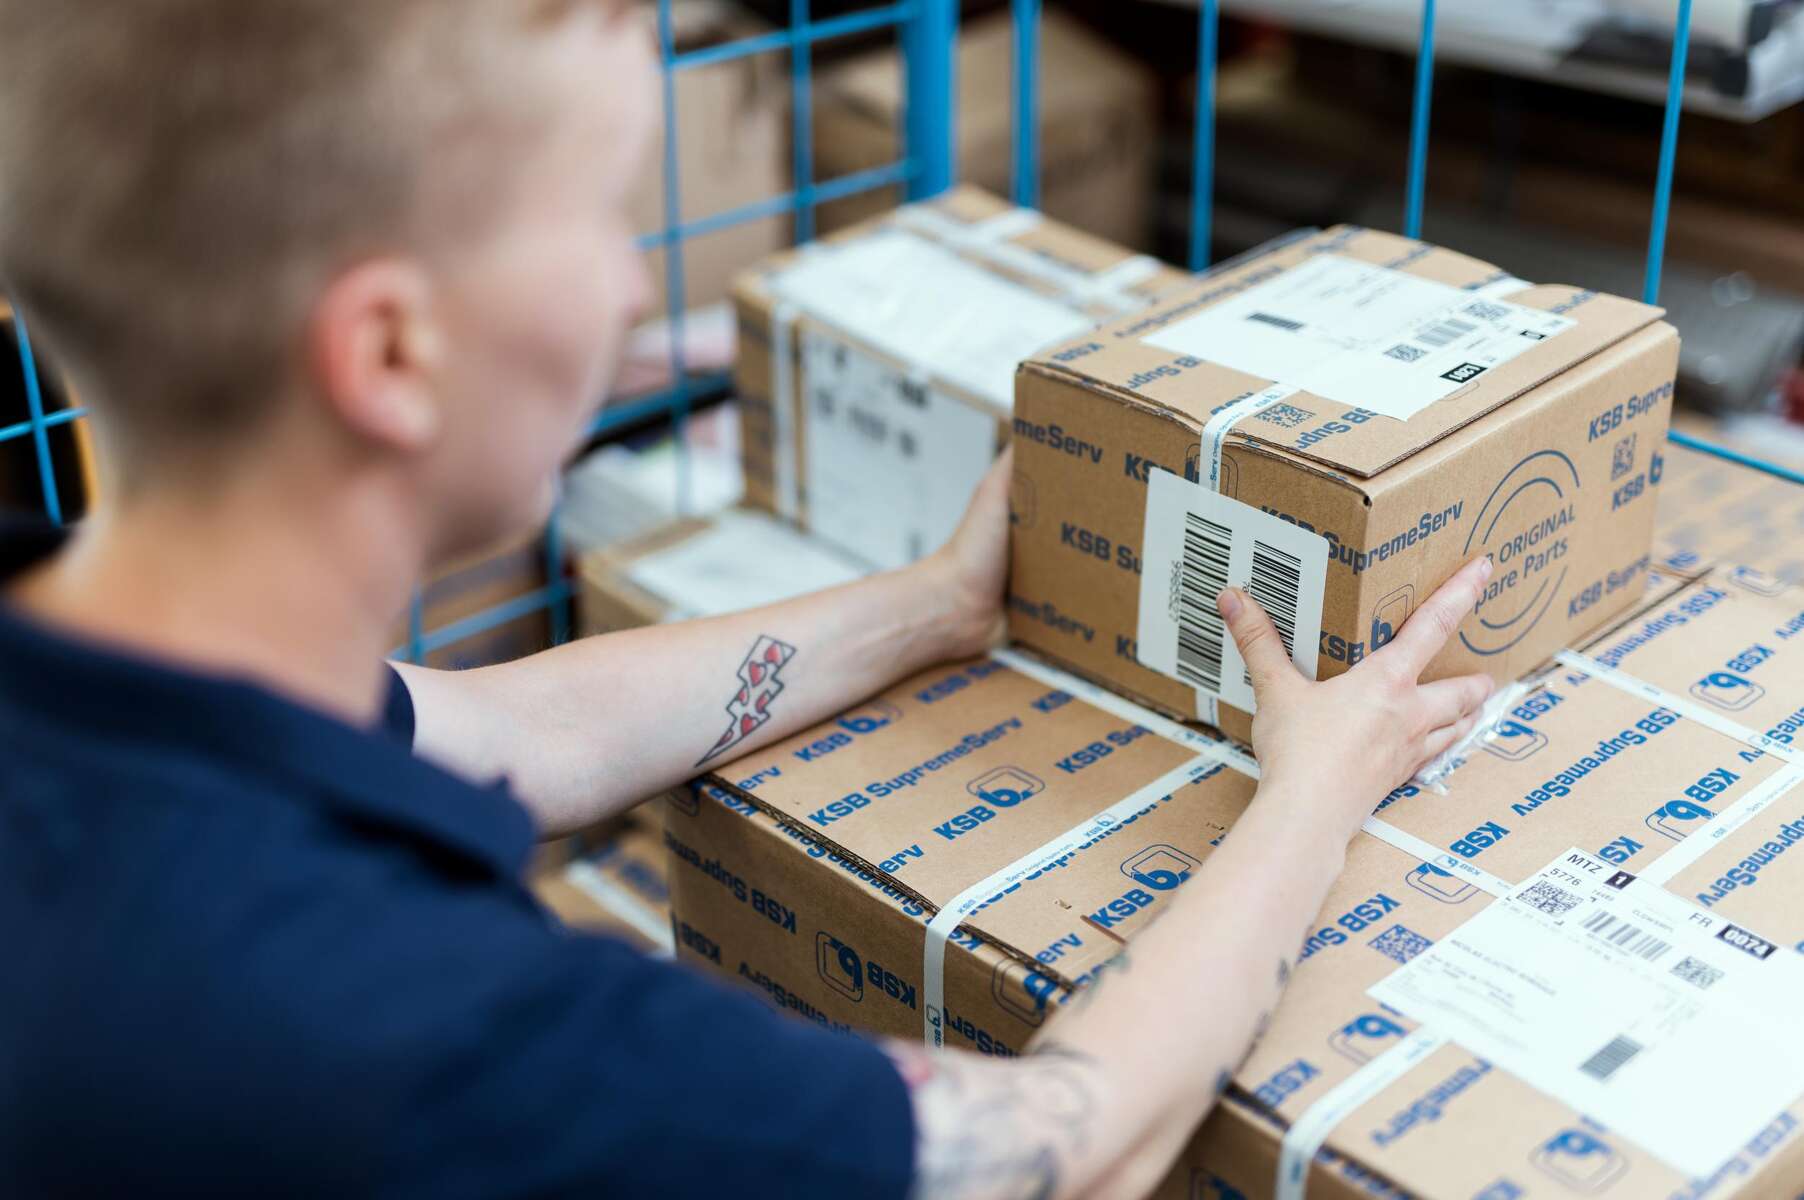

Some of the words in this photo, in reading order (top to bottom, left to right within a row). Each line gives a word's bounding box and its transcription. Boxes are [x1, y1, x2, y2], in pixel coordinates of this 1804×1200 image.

[1588, 404, 1623, 443] KSB
[1626, 381, 1672, 418] Supre
[1013, 416, 1103, 464] meServ
[1297, 421, 1352, 449] Supr
[1210, 459, 1218, 481] Serv
[1611, 473, 1645, 512] KSB
[1061, 522, 1111, 561] KSB
[1323, 500, 1463, 576] SupremeServ
[1499, 503, 1576, 564] ORIGINAL
[1523, 537, 1569, 579] Parts
[1568, 580, 1602, 620] KSB
[1680, 587, 1728, 616] KSB
[1726, 643, 1776, 673] KSB
[1512, 691, 1565, 721] KSB
[793, 732, 853, 763] KSB
[1054, 740, 1115, 774] KSB
[807, 793, 872, 827] KSB
[865, 716, 1023, 798] SupremeServ
[1510, 730, 1647, 817] SupremeServ
[1683, 767, 1741, 803] KSB
[931, 805, 997, 841] KSB
[1449, 821, 1511, 859] KSB
[877, 844, 925, 875] erv
[1567, 854, 1603, 874] MTZ
[1594, 836, 1645, 867] KS
[1550, 868, 1582, 887] 5776
[751, 888, 797, 935] KSB
[1089, 887, 1155, 929] KSB
[1339, 893, 1402, 933] KSB
[1036, 932, 1084, 965] erv
[1688, 912, 1713, 928] FR
[1723, 928, 1770, 956] 0074
[867, 960, 917, 1011] KSB
